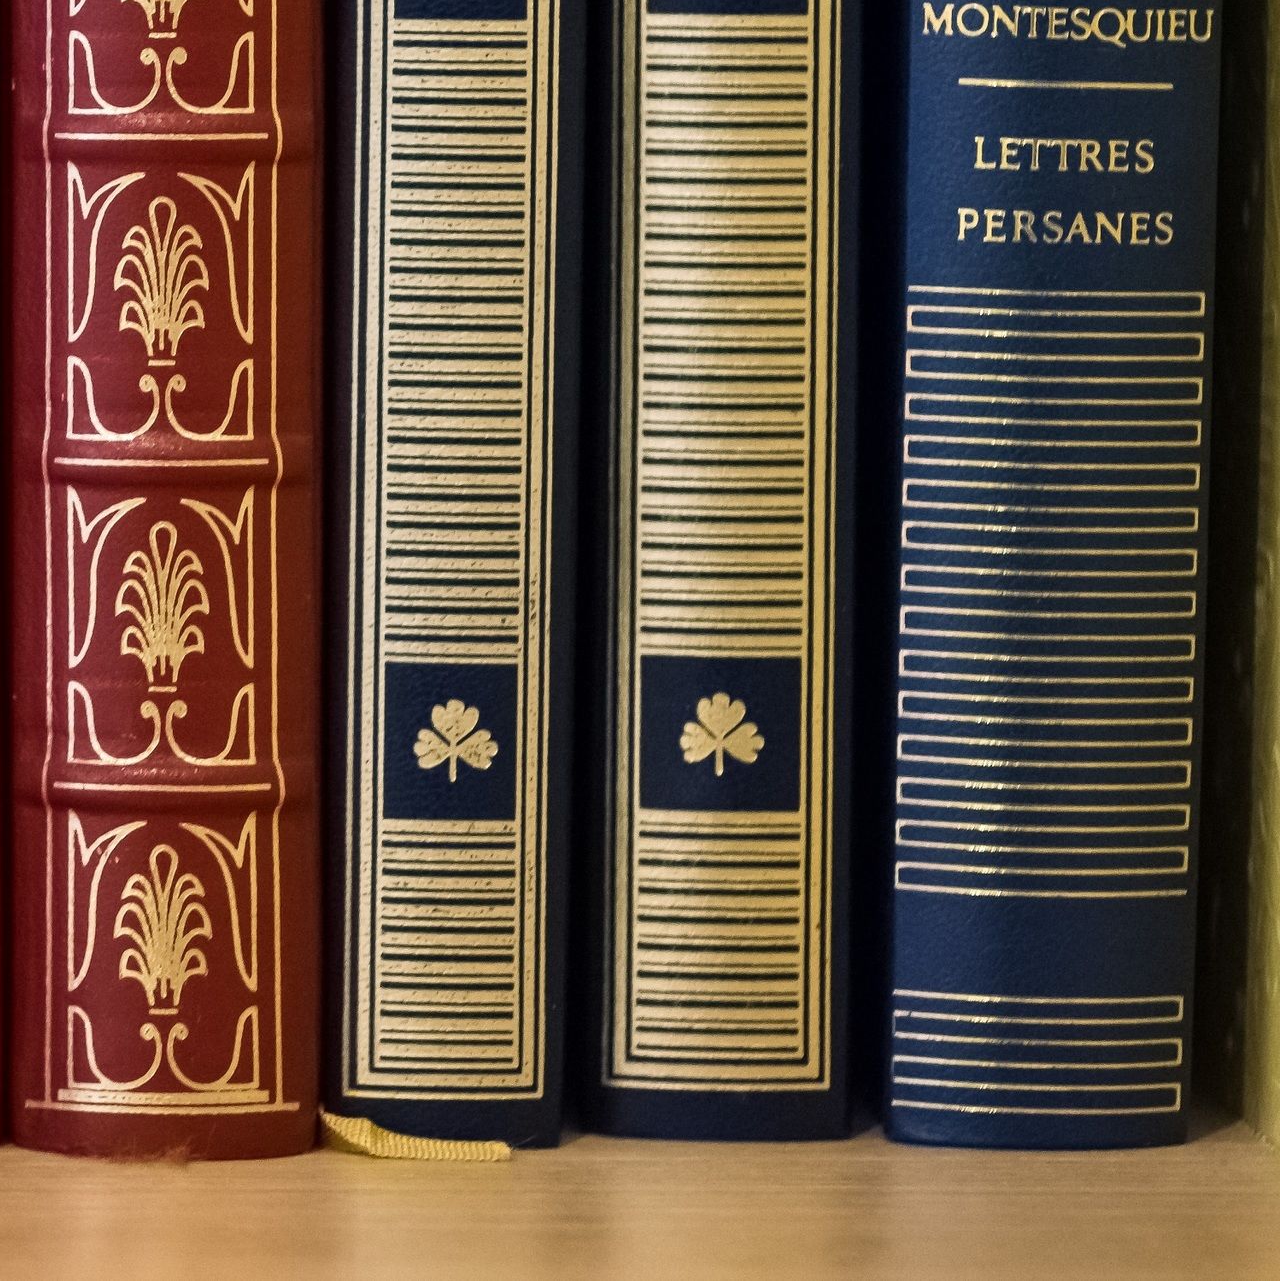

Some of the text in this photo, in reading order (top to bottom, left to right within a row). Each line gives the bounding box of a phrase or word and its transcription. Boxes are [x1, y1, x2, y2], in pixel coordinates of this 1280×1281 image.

[923, 3, 1213, 47] MONTESQUIEU
[974, 136, 1154, 172] LETTRES
[958, 208, 1172, 244] PERSANES
